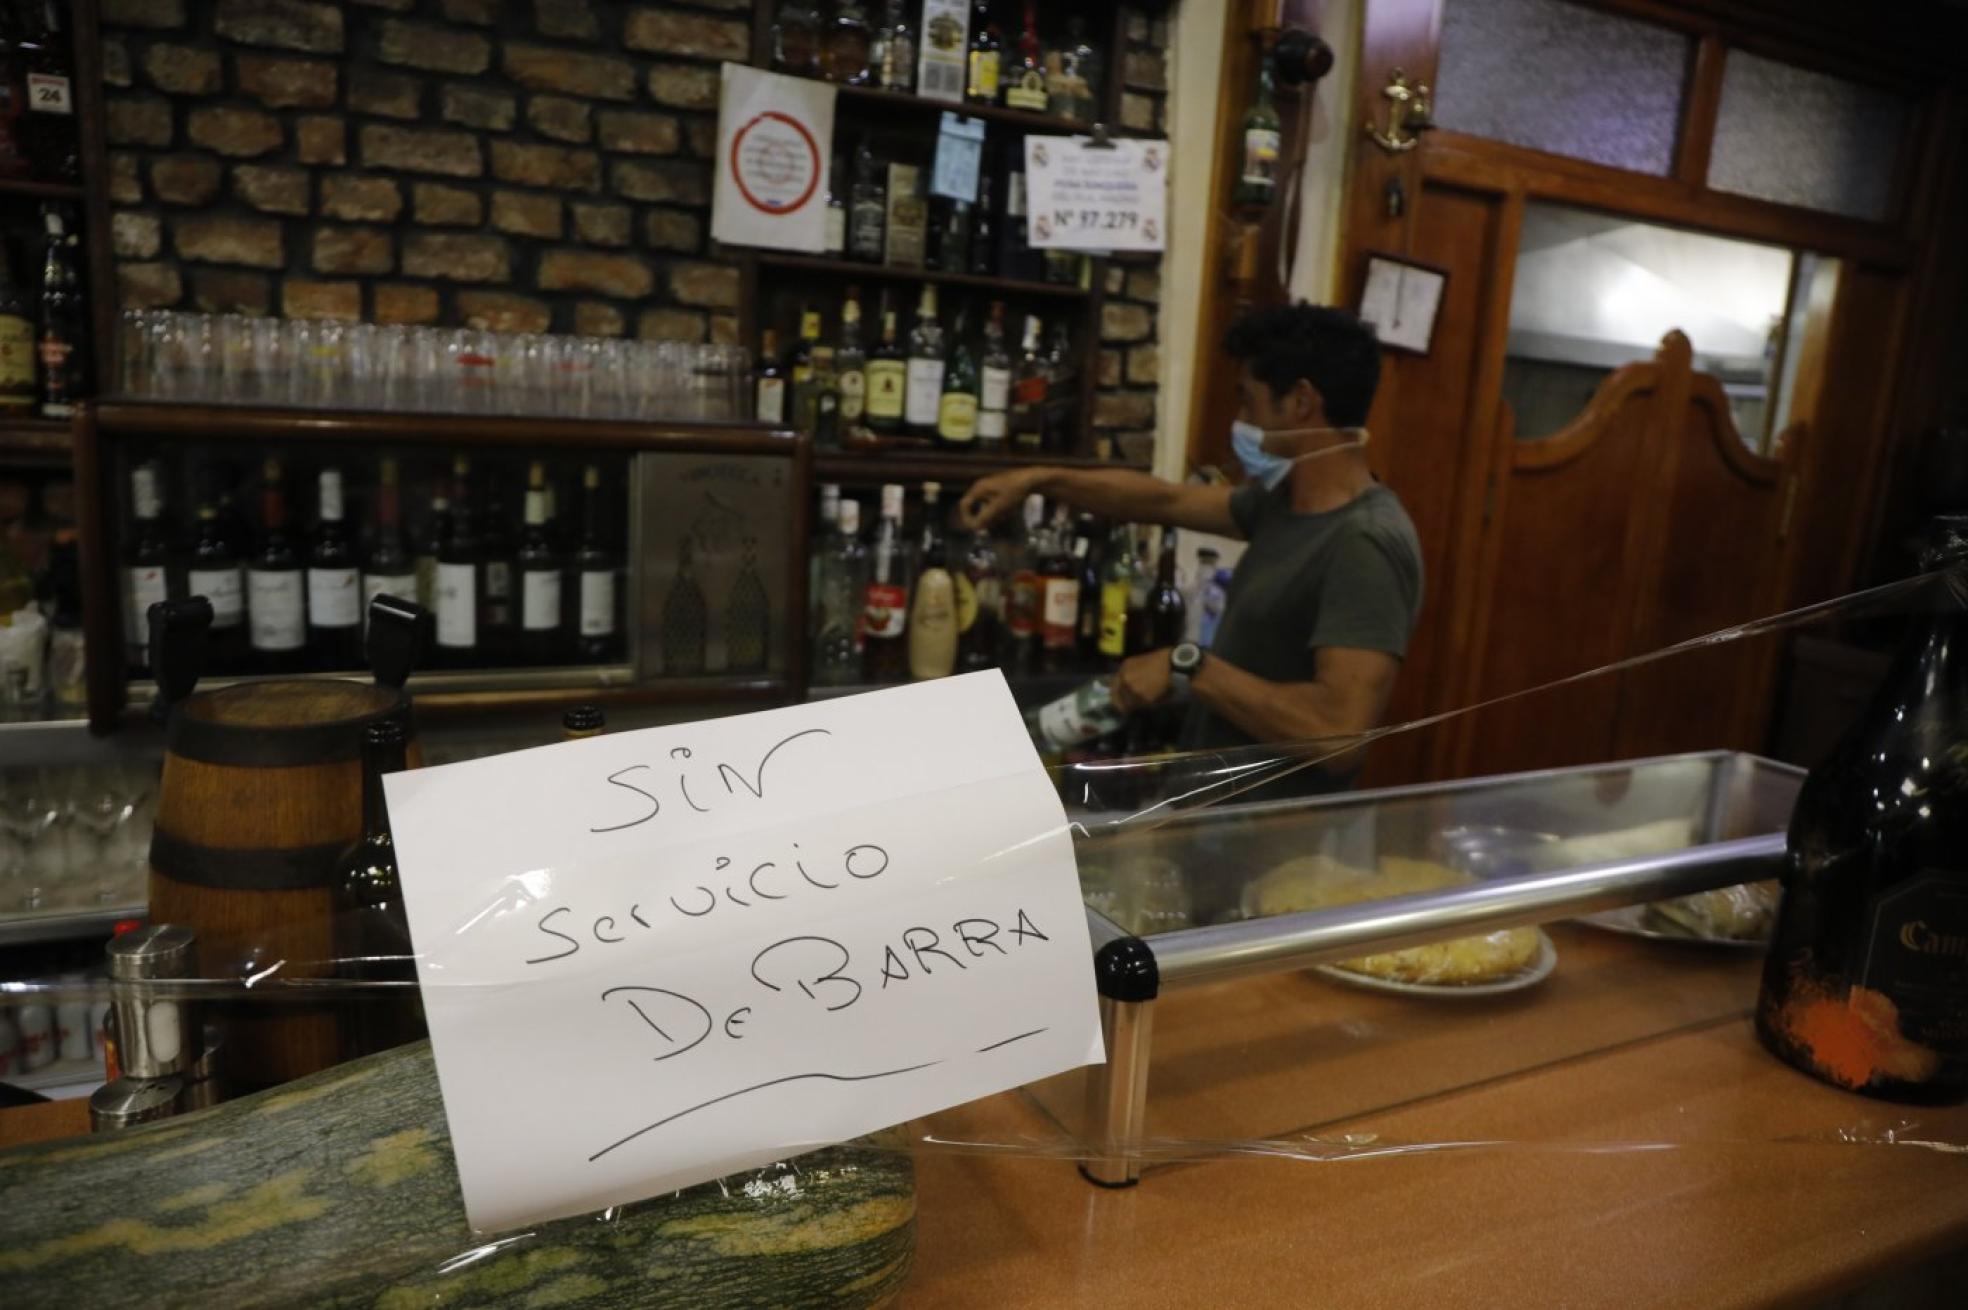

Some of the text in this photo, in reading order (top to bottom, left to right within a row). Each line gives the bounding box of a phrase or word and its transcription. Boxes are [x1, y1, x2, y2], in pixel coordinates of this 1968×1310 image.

[40, 88, 62, 103] 24
[526, 842, 889, 964] Servicio
[751, 908, 1050, 1012] BARRA
[1901, 920, 1968, 960] Cam
